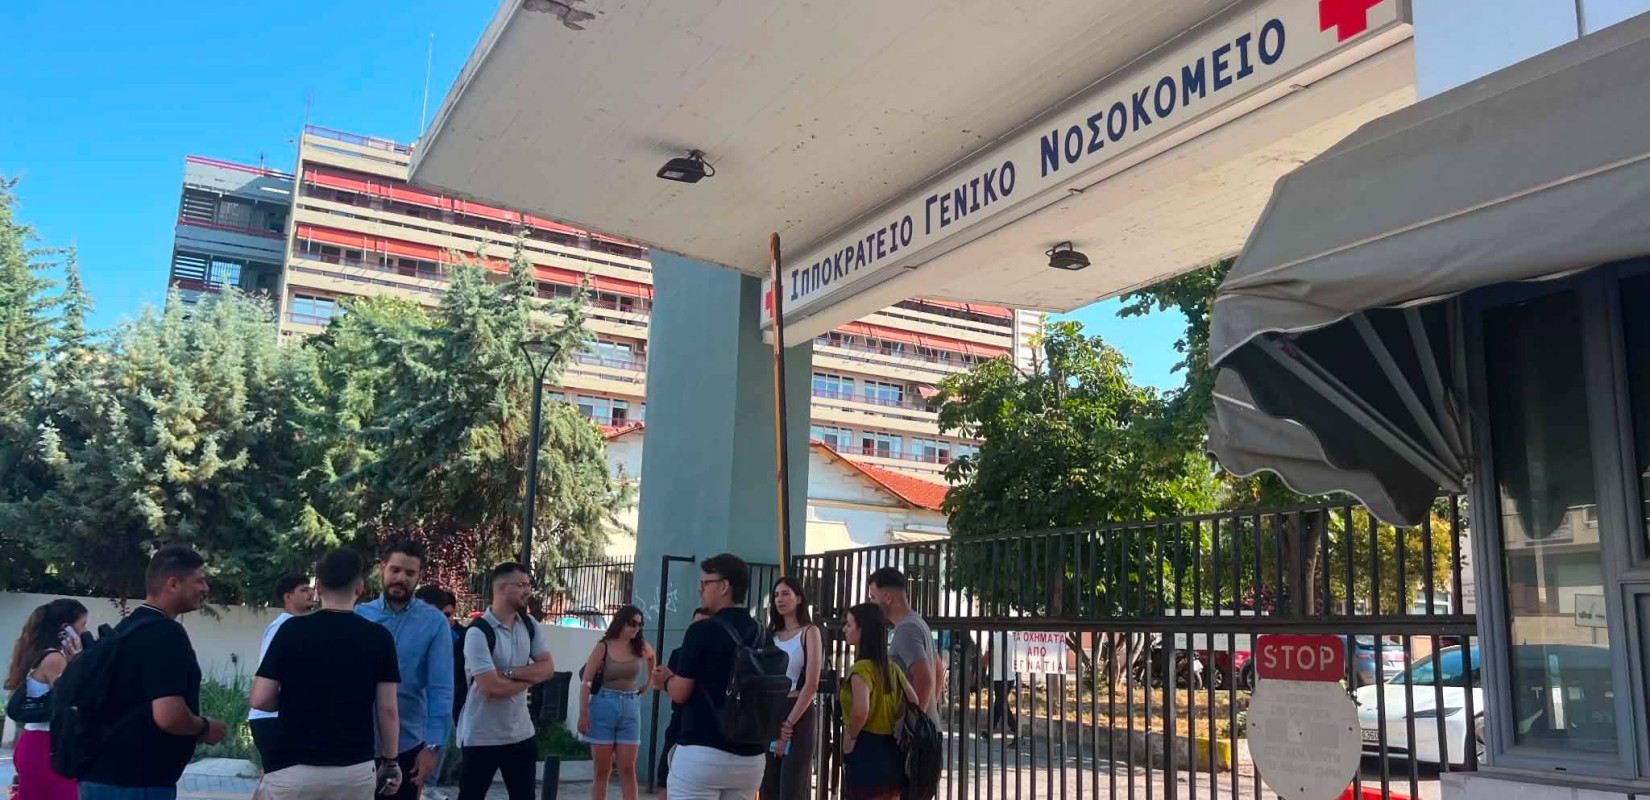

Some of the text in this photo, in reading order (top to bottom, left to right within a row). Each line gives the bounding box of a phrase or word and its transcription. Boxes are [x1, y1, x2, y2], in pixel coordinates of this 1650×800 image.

[790, 18, 1286, 302] ΙΠΠΟΚΡΑΤΕΙΟ ΓΕΝΙΚΟ ΝΟΣΟΚΟΜΕΙΟ
[1012, 631, 1066, 644] ΤΑ ΟΧΗΜΑΤΑ
[1027, 646, 1047, 657] ΑΠΟ
[1263, 644, 1335, 671] STOP
[1014, 659, 1064, 672] ΕΓΝΑΤΙΑ
